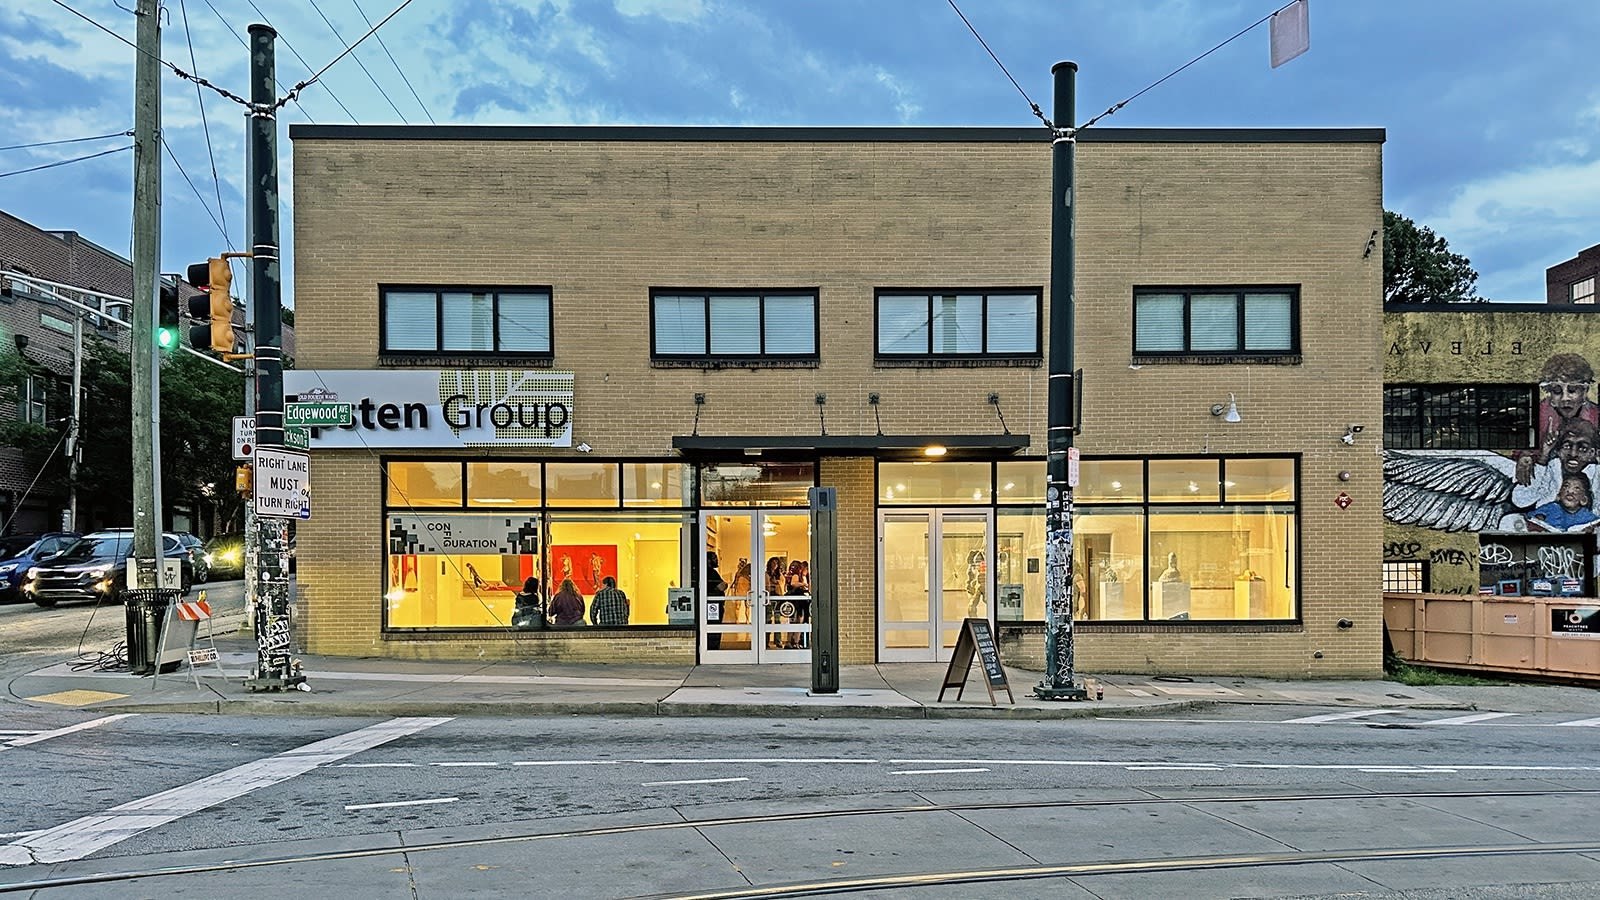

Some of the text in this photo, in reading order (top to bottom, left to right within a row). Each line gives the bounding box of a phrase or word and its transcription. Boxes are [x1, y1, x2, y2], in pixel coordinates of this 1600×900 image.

[287, 405, 349, 424] Edgewood AVE
[442, 394, 569, 438] Group
[242, 419, 256, 429] NO
[284, 429, 304, 445] ckson
[259, 457, 307, 472] RIGHT LANE
[270, 477, 299, 491] MUST
[258, 497, 308, 510] TURN RIGHT
[427, 523, 451, 531] CON
